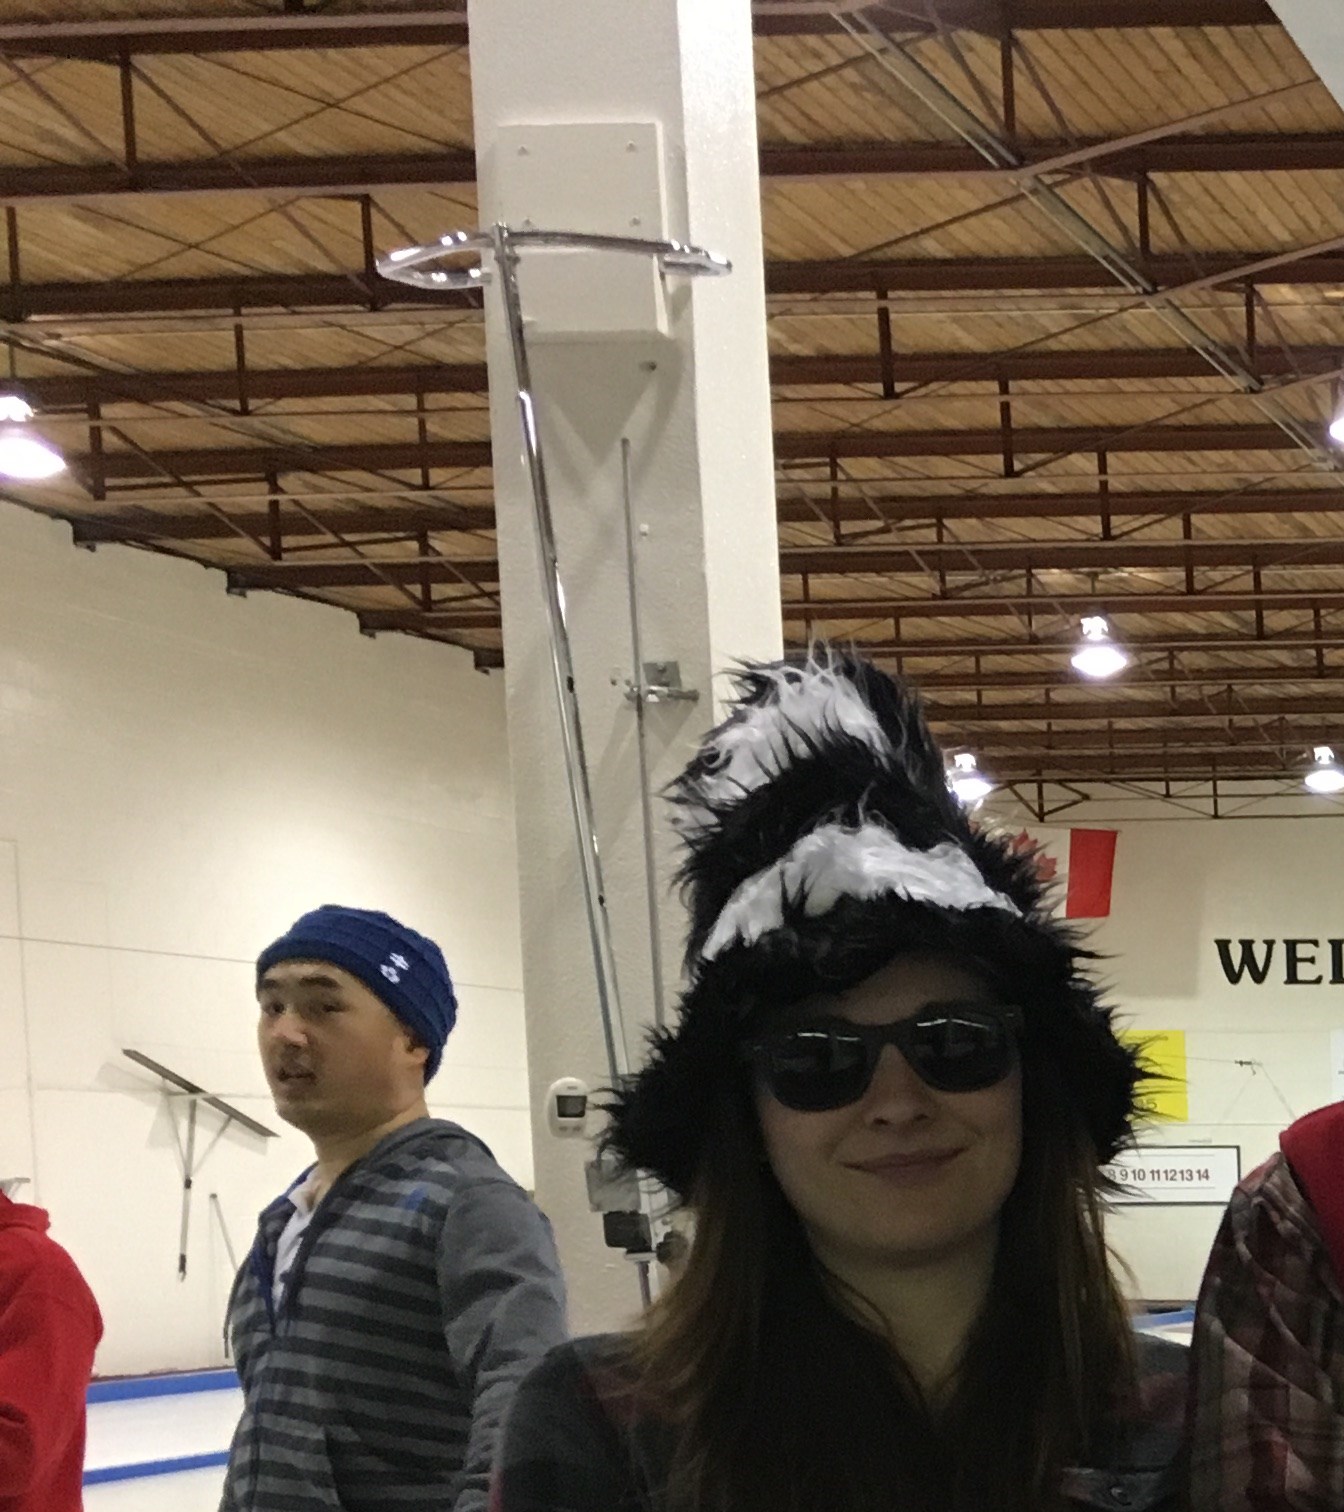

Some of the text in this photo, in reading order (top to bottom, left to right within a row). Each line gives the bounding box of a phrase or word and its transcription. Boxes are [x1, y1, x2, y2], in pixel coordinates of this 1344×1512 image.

[1120, 1168, 1129, 1181] 9
[1132, 1168, 1147, 1181] 10
[1150, 1168, 1162, 1181] 11
[1163, 1168, 1178, 1181] 12
[1179, 1168, 1194, 1181] 13
[1195, 1168, 1210, 1181] 14
